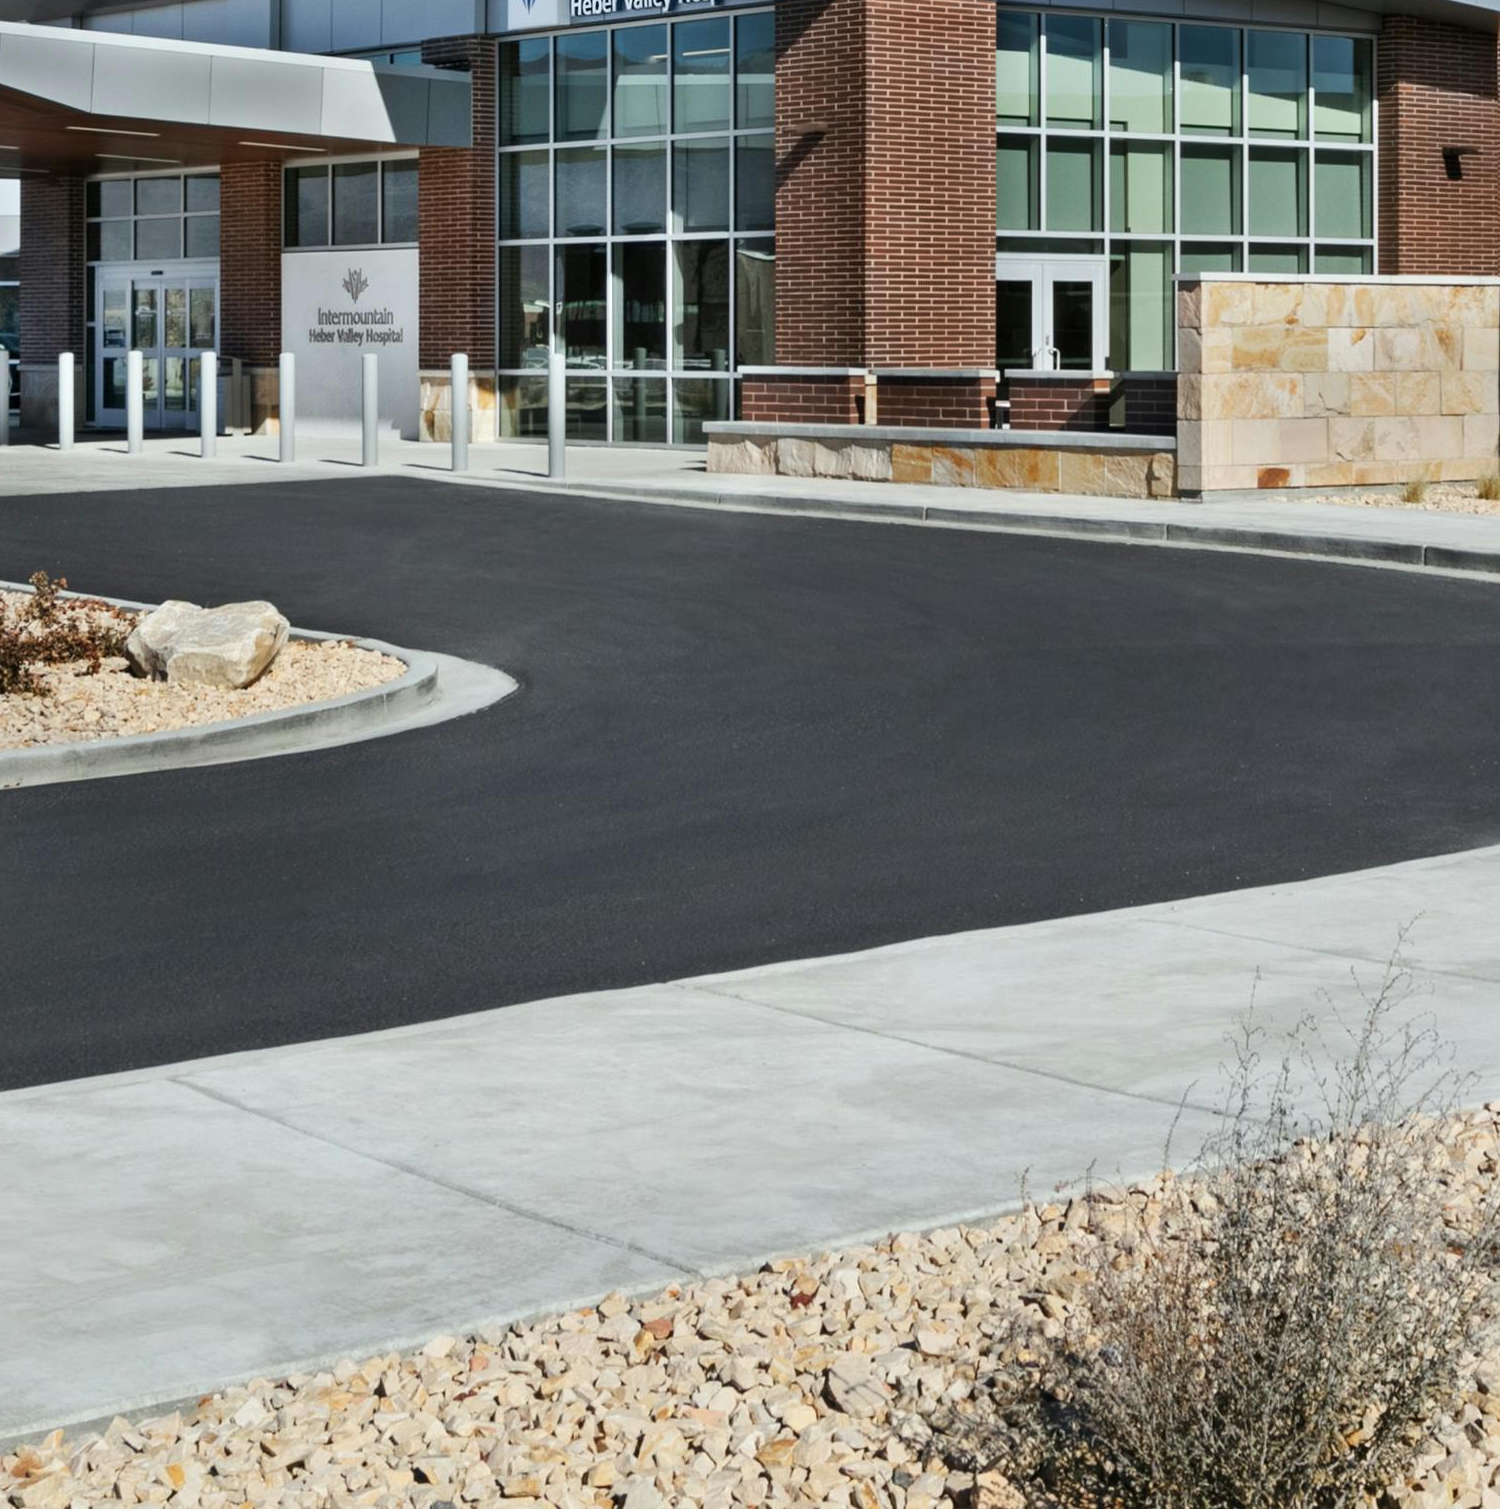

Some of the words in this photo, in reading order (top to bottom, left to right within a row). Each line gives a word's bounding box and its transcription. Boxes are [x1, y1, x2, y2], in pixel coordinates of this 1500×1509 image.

[318, 307, 394, 325] Intermountain
[309, 328, 335, 344] Heber
[337, 328, 364, 346] Valley
[366, 328, 403, 346] Hospital
